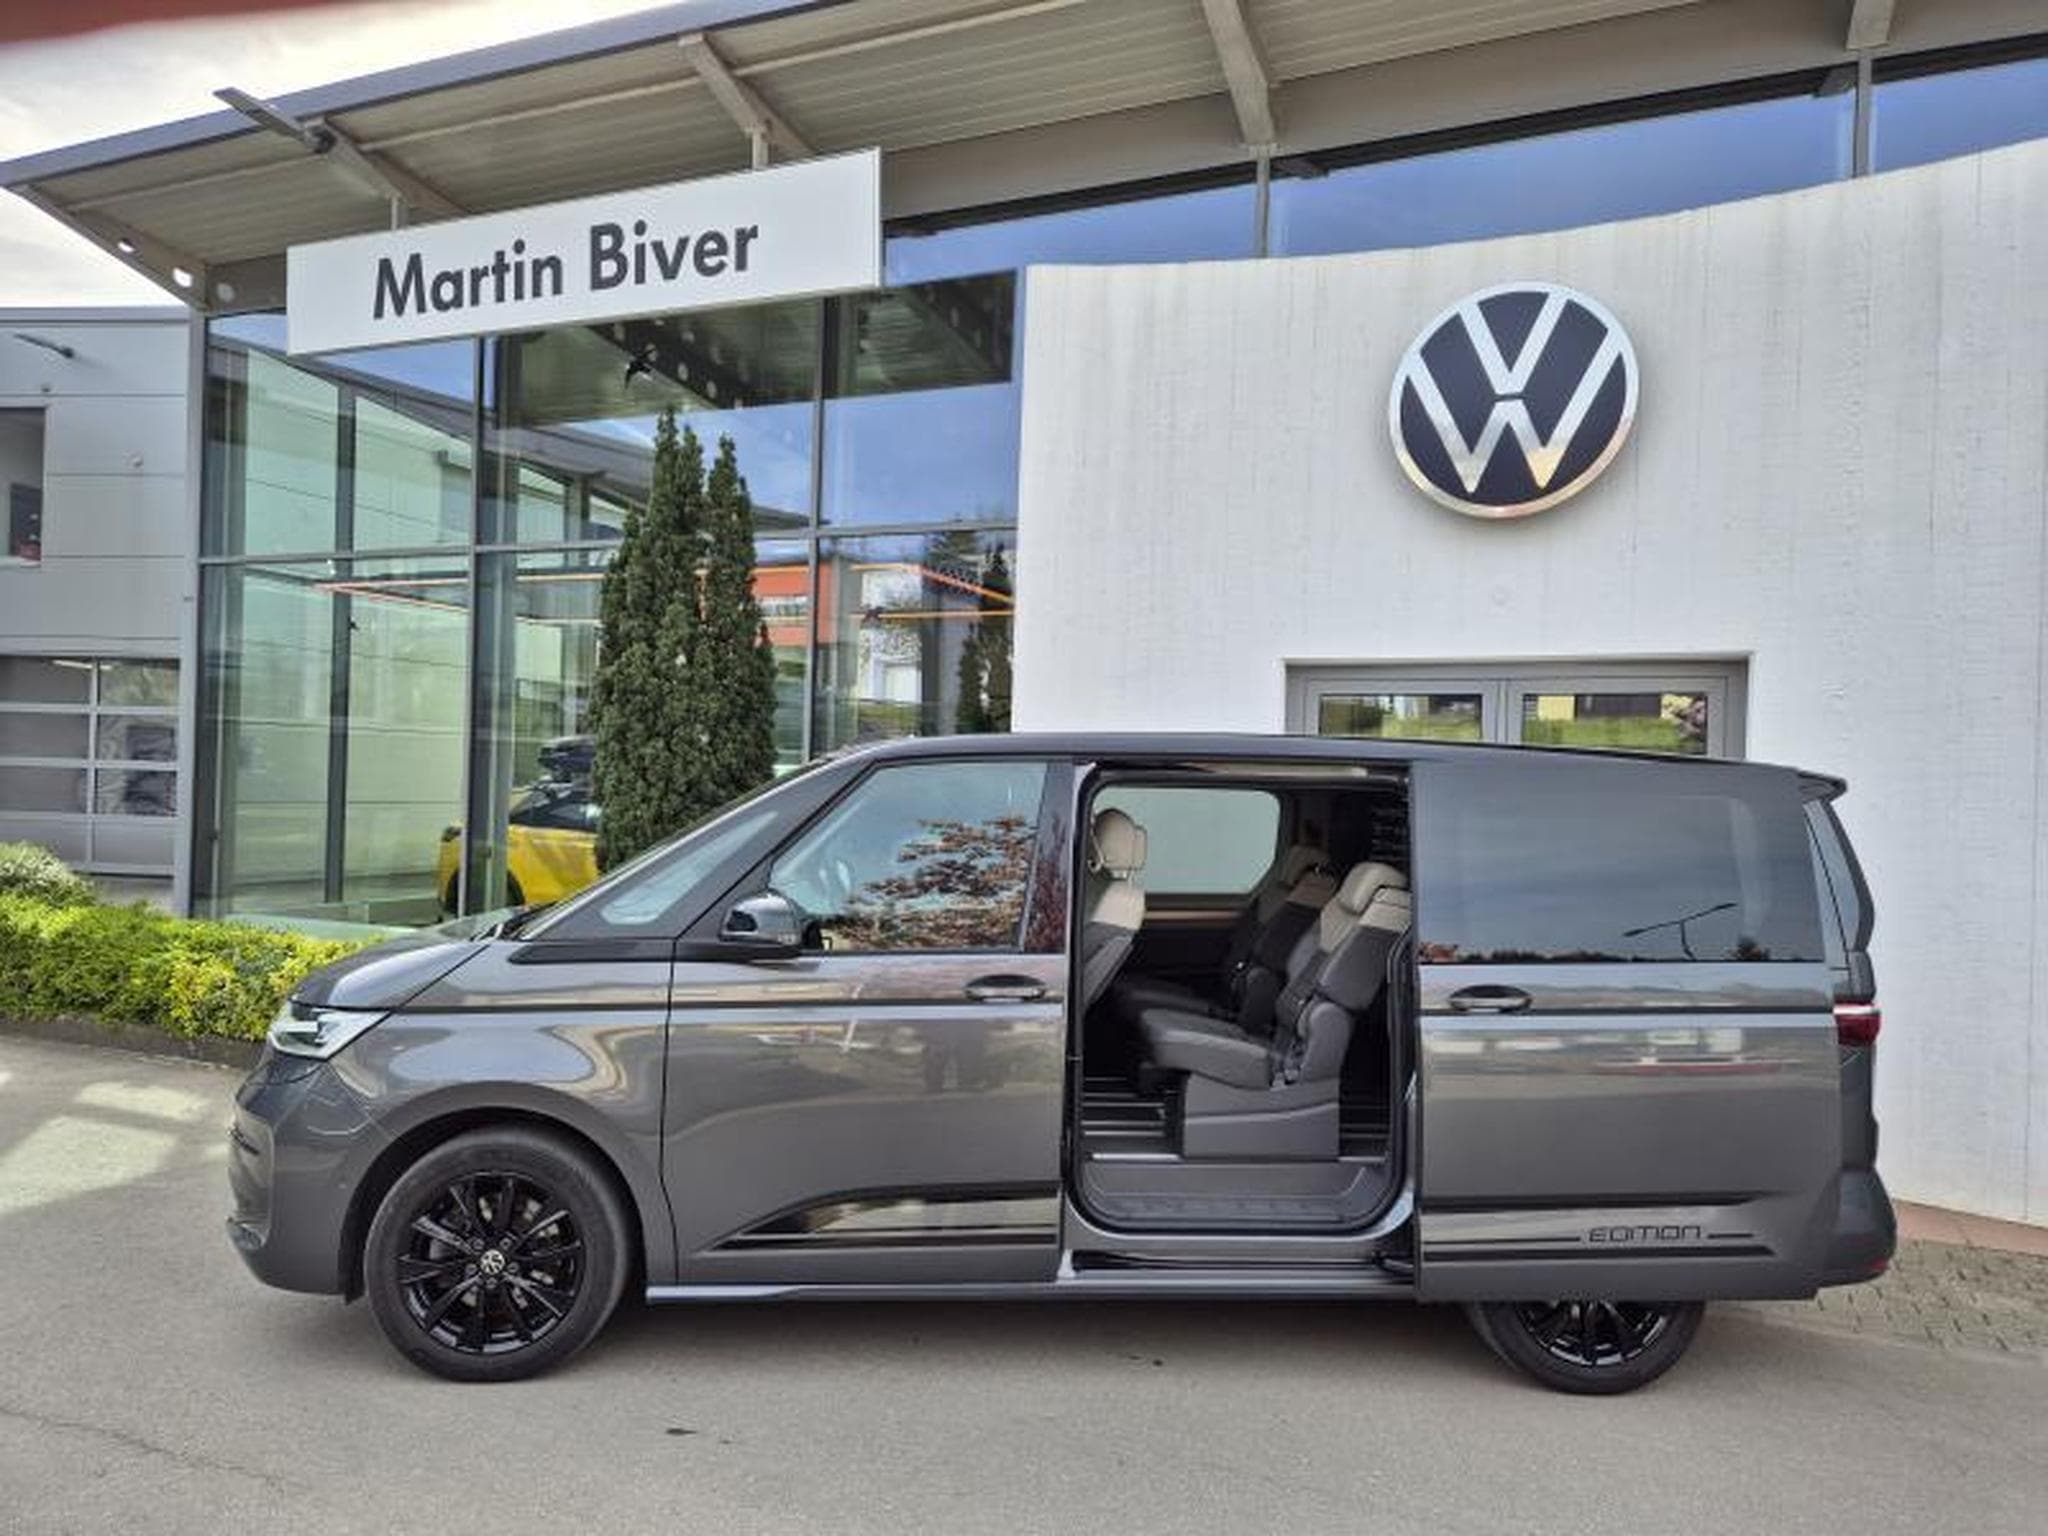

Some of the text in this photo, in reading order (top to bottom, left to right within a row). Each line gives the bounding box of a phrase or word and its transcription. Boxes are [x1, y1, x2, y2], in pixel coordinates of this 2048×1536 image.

[373, 219, 759, 320] Martin Biver
[1398, 284, 1635, 496] VW
[1589, 1225, 1701, 1243] EDITION
